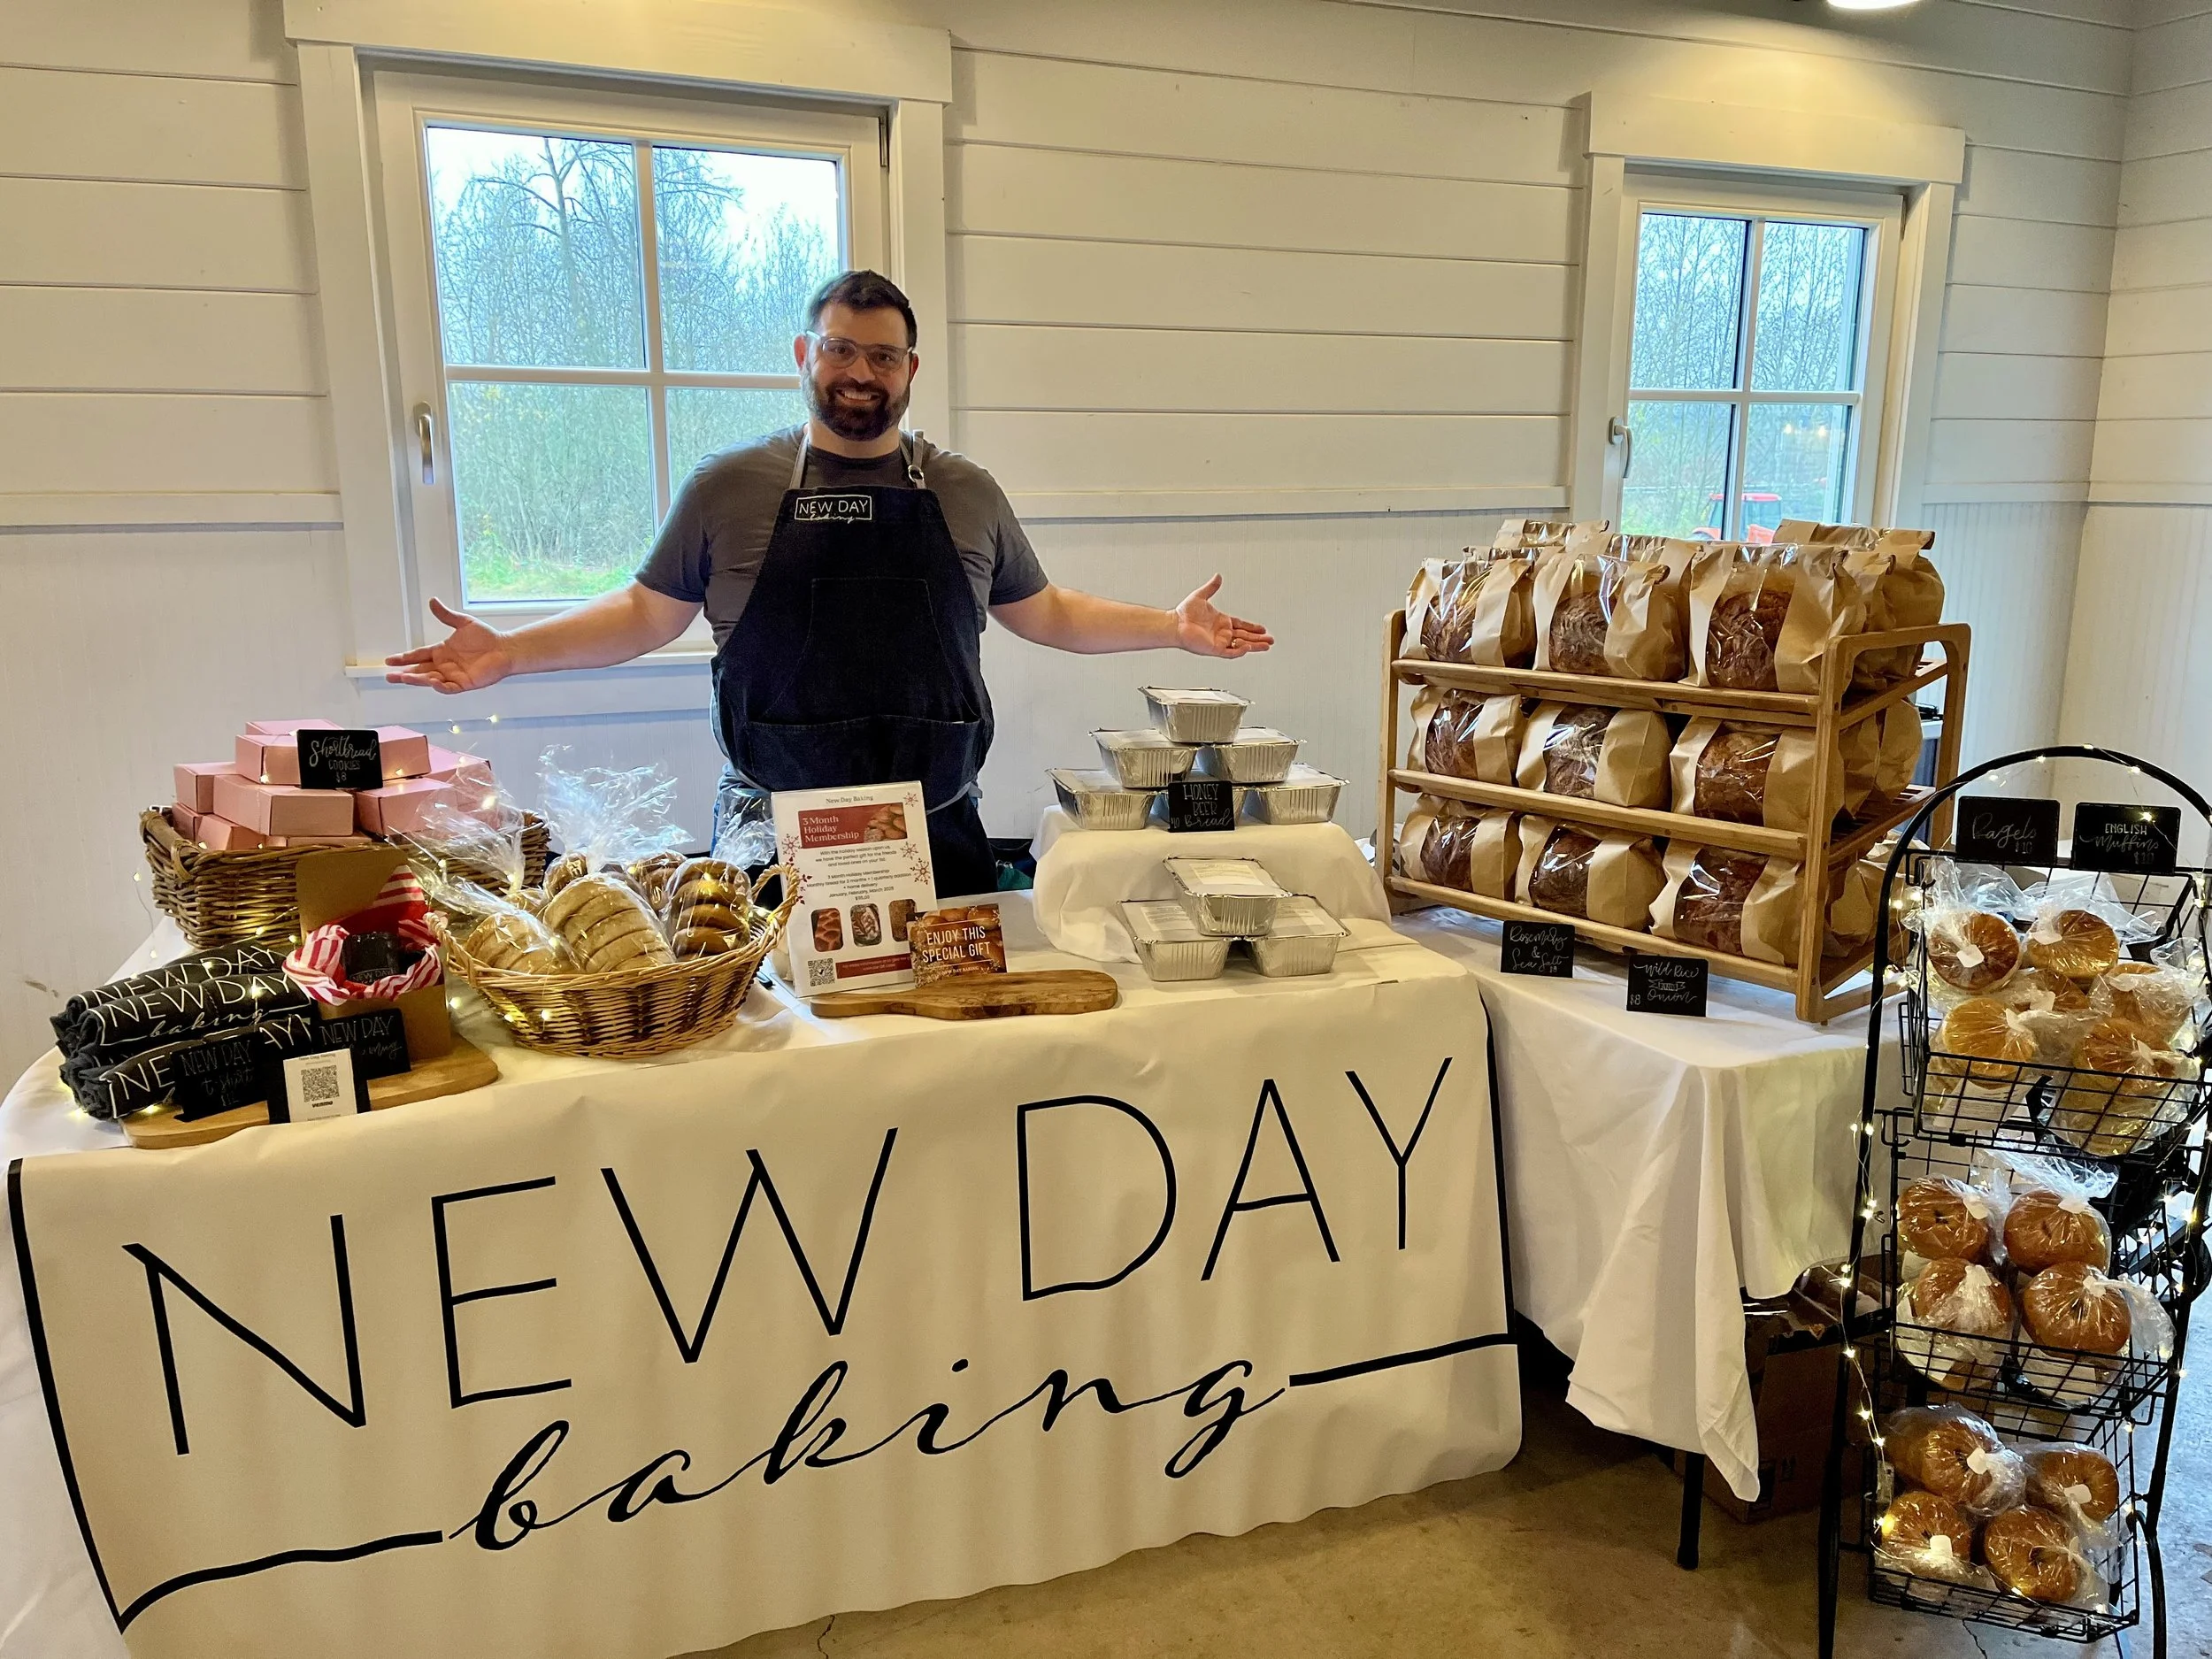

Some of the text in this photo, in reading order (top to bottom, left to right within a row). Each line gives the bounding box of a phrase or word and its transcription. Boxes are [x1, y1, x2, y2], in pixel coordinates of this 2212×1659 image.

[799, 499, 868, 514] NEW DAY
[810, 511, 855, 524] baking
[309, 734, 378, 768] Shortbread
[1183, 783, 1219, 801] HONEY
[1185, 808, 1233, 828] Bread
[1193, 801, 1217, 817] BEER
[803, 825, 838, 835] Holiday
[809, 815, 839, 825] Month
[2104, 822, 2148, 836] ENGLISH
[805, 832, 860, 843] Membership
[1971, 812, 2037, 849] Bagels
[926, 926, 986, 946] ENJOY THIS
[922, 943, 966, 964] SPECIAL
[969, 941, 991, 957] GIFT
[1511, 948, 1570, 972] Sea Salt
[1531, 946, 1541, 958] &
[92, 945, 275, 1007] NEW DAY
[1635, 961, 1700, 978] Wild Rice
[103, 972, 290, 1028] NEW DAY
[1630, 989, 1698, 1006] $8 Onion
[147, 1008, 268, 1039] baking
[319, 1015, 395, 1046] NEW DAY
[113, 1054, 176, 1100] NE
[258, 1013, 295, 1049] AY
[180, 1039, 253, 1077] NEW DAY
[121, 1056, 1454, 1456] NEW DAY
[448, 1357, 1287, 1552] baking
